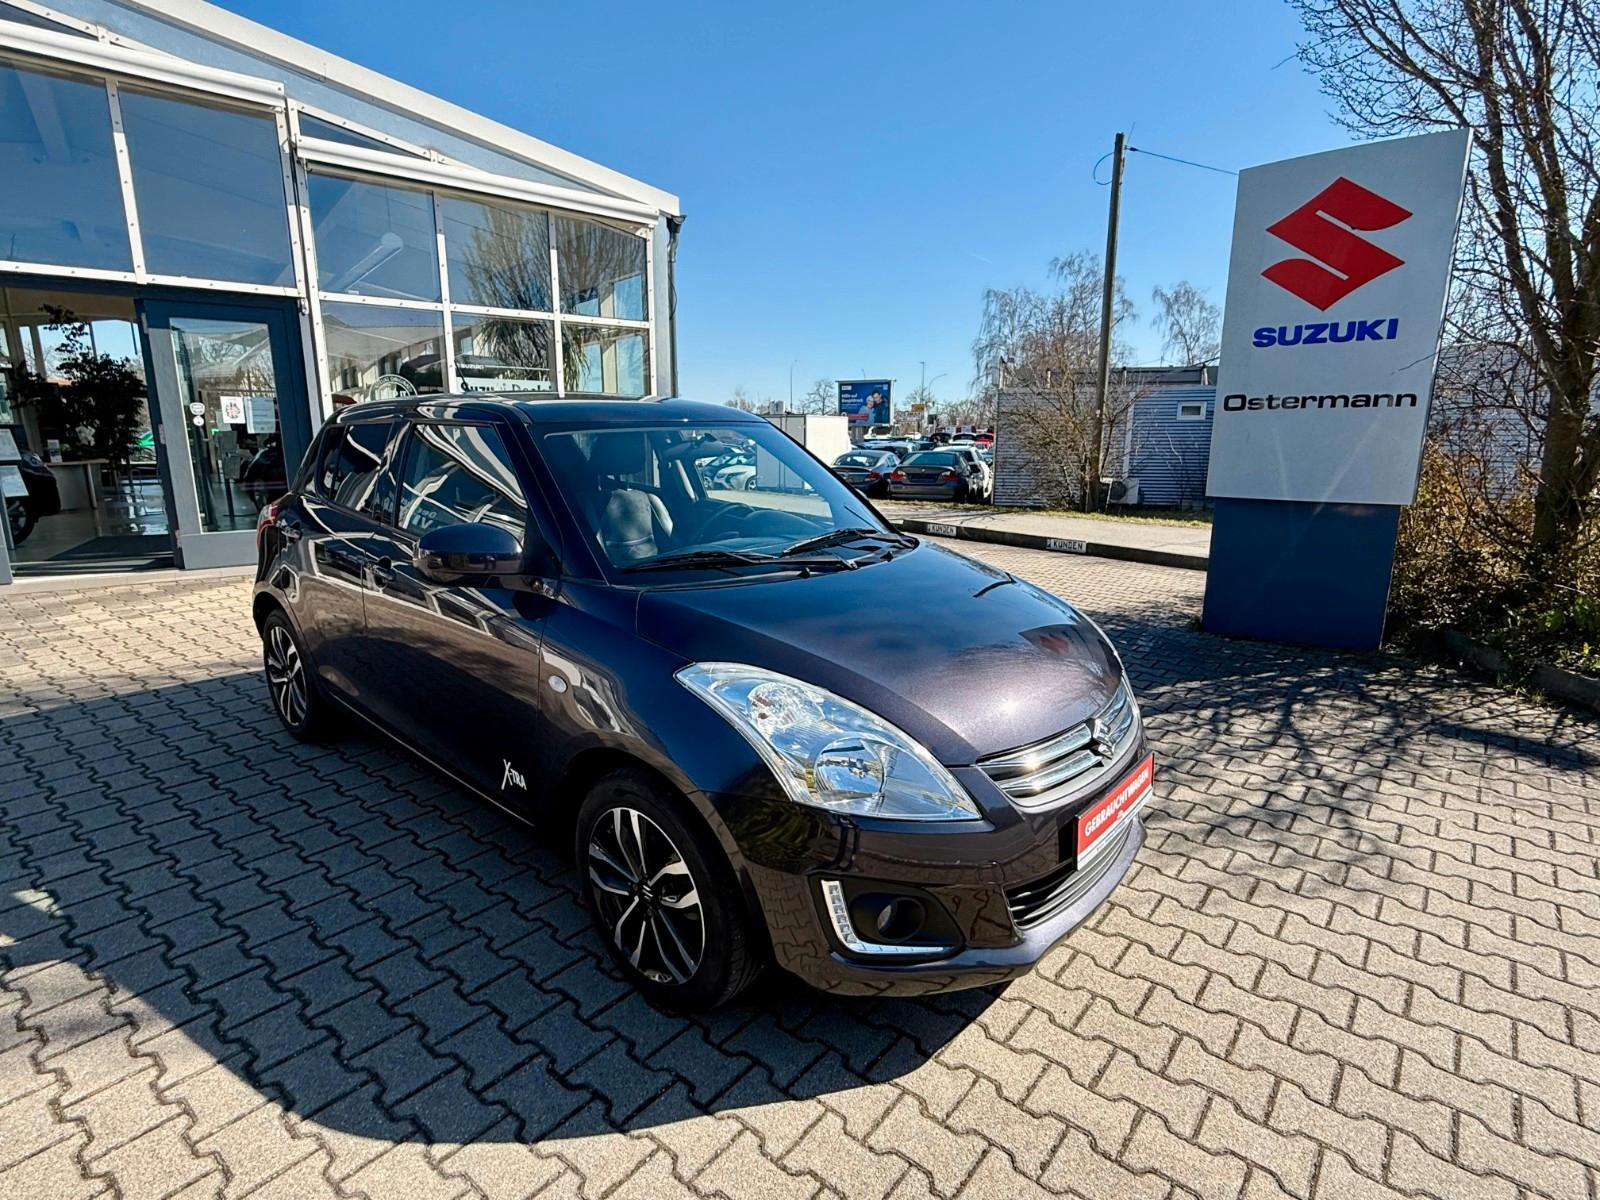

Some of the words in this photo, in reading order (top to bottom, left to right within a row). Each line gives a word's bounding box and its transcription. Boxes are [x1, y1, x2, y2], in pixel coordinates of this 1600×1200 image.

[1252, 318, 1399, 347] SUZUKI
[1223, 393, 1417, 411] Ostermann
[932, 524, 954, 534] KUNDEN
[1053, 539, 1083, 551] KUNDEN
[1084, 768, 1149, 837] GEBRAUCHTWAGEN
